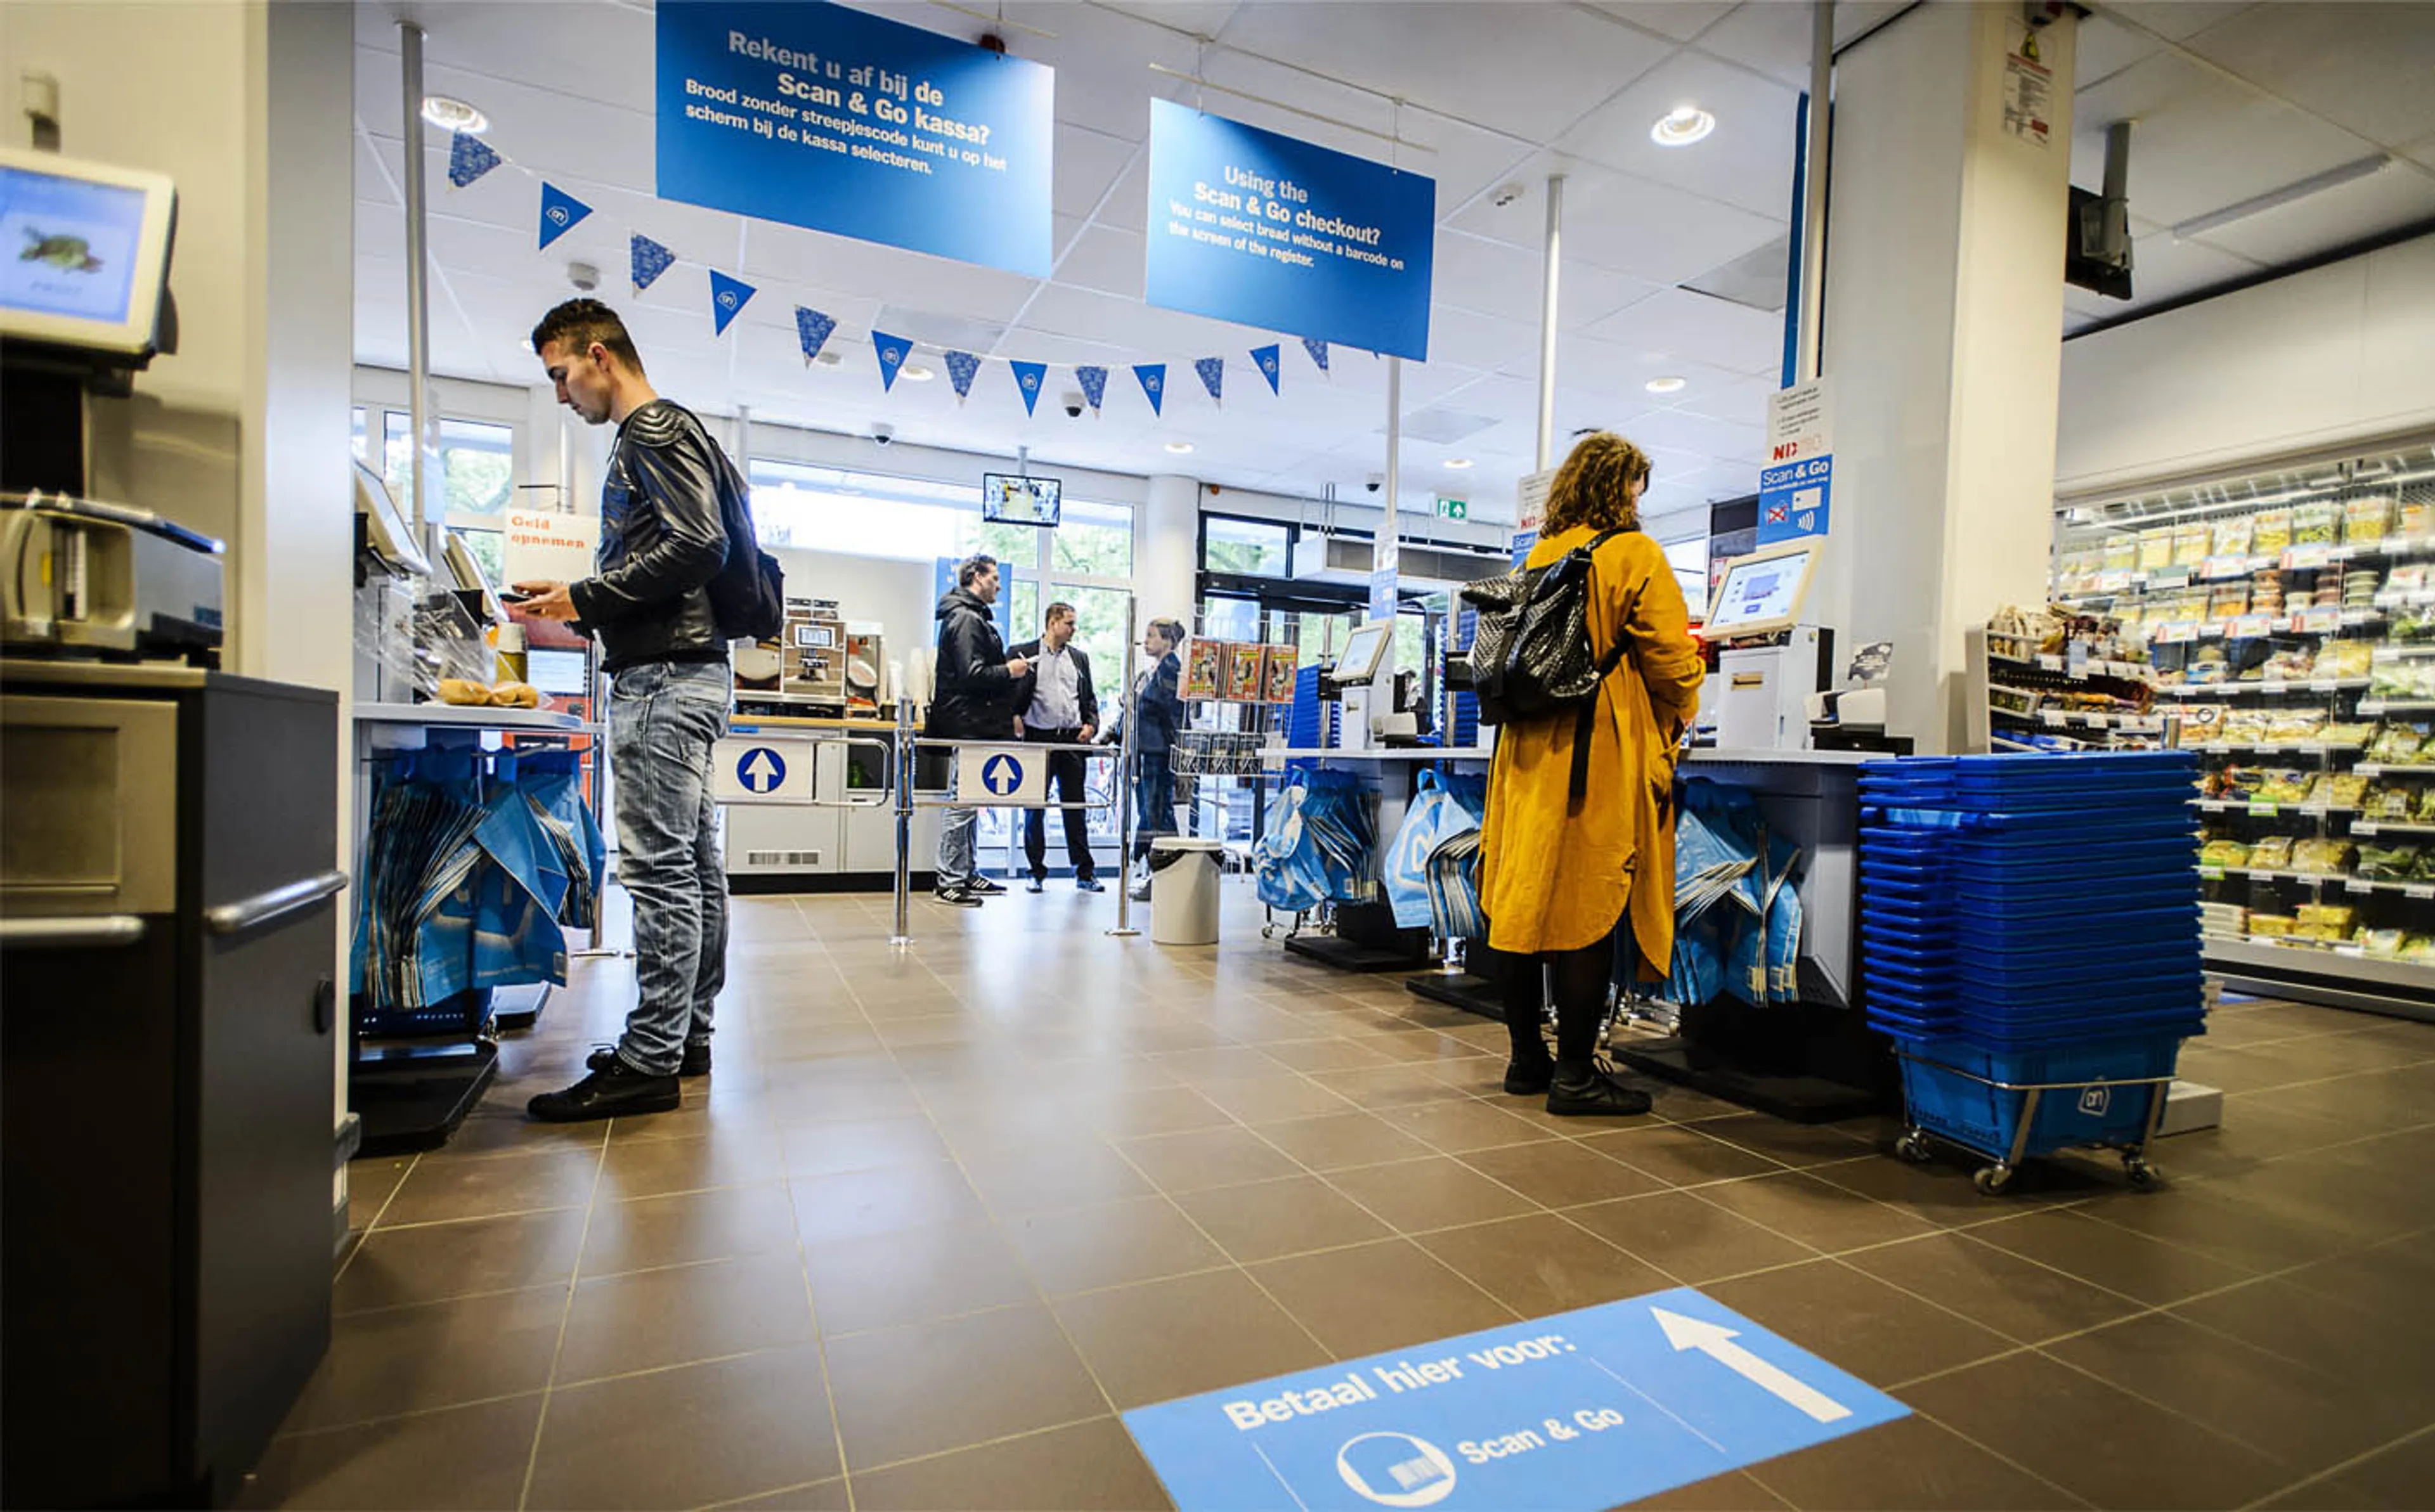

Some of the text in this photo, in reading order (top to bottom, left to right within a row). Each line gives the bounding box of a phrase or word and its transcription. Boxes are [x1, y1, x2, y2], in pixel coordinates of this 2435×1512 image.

[729, 29, 944, 106] Rekent u af bij de
[685, 79, 1006, 172] Brood zonder streepjescode kunt u op het
[685, 105, 932, 174] scherm bij de kassa selecteren.
[777, 73, 990, 145] Scan & Go kassa?
[1194, 183, 1381, 245] Scan & Go checkout?
[1224, 165, 1308, 203] Using the
[1169, 221, 1315, 268] the screen of the register.
[1170, 200, 1404, 270] You can select bread without a barcode on
[1763, 469, 1793, 486] Scan
[1795, 465, 1807, 479] &
[1809, 461, 1829, 475] Go
[511, 515, 550, 530] Geld
[511, 534, 585, 548] opnemen
[1223, 1333, 1577, 1431] Betaal hier voor:
[1457, 1407, 1625, 1465] Scan & Go
